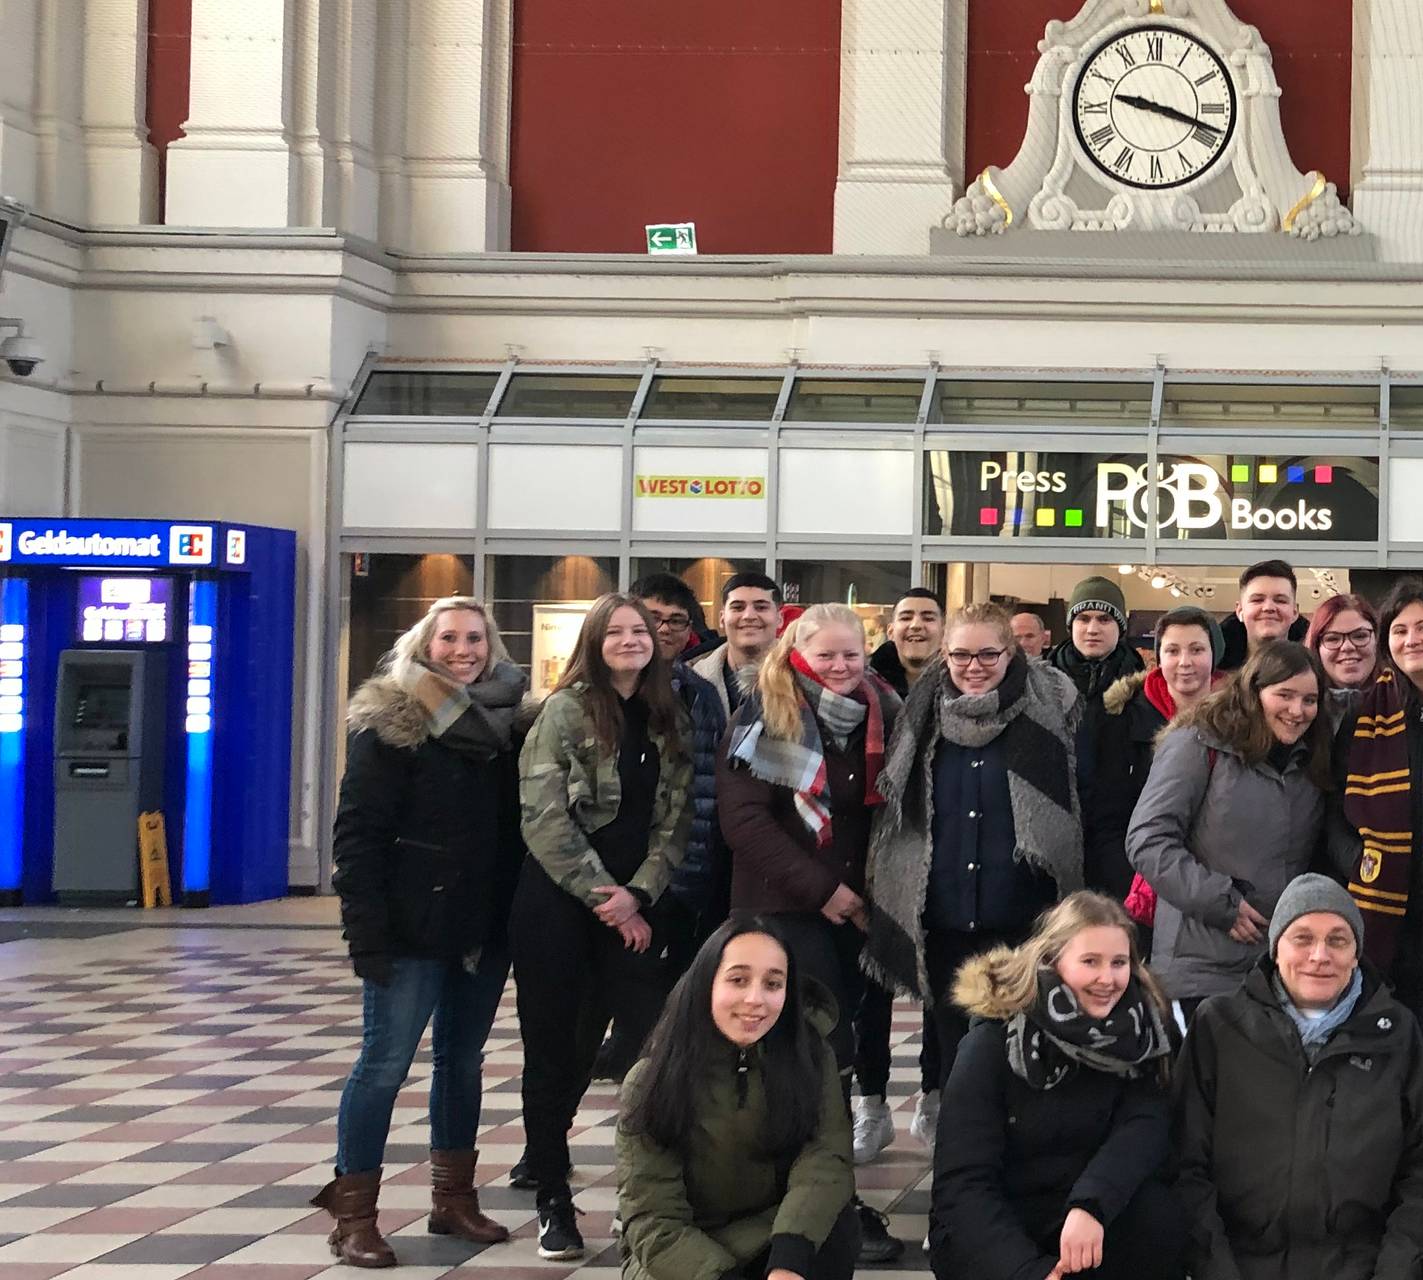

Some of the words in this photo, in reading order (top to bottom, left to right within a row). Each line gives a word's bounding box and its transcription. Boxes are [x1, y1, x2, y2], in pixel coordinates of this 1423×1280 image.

[980, 461, 1067, 493] Press
[1231, 499, 1332, 531] Books
[18, 530, 161, 557] Geldautomat
